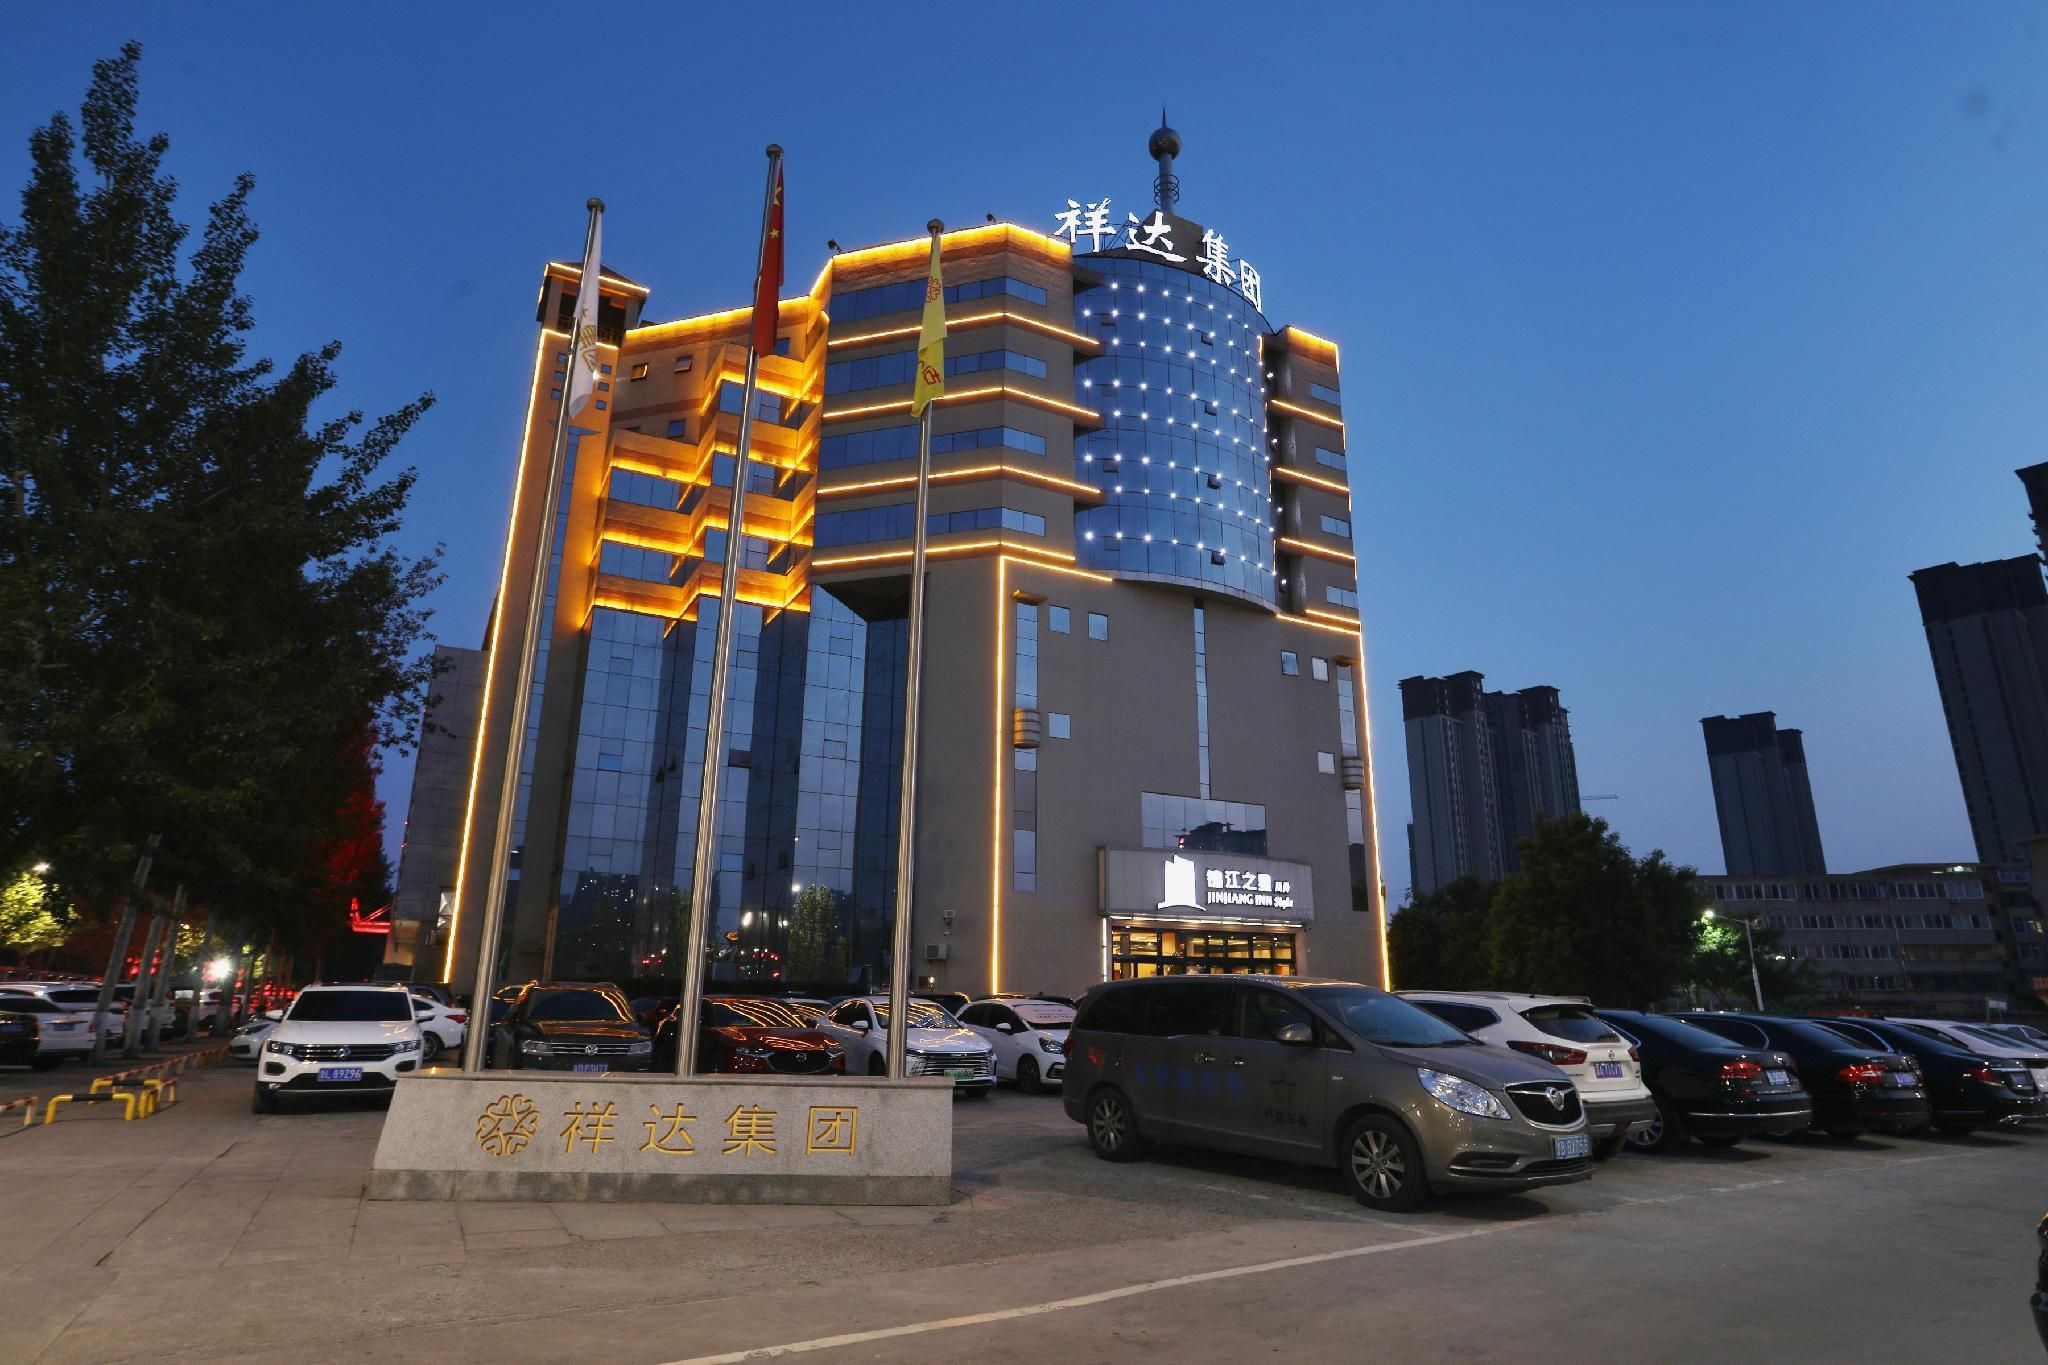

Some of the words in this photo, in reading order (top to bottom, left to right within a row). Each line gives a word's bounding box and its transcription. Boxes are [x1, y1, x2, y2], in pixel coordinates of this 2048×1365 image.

[1053, 198, 1262, 313] 祥达集团
[1207, 891, 1254, 905] JINJIANG
[1255, 894, 1273, 907] INN
[560, 1101, 858, 1157] 祥达集团
